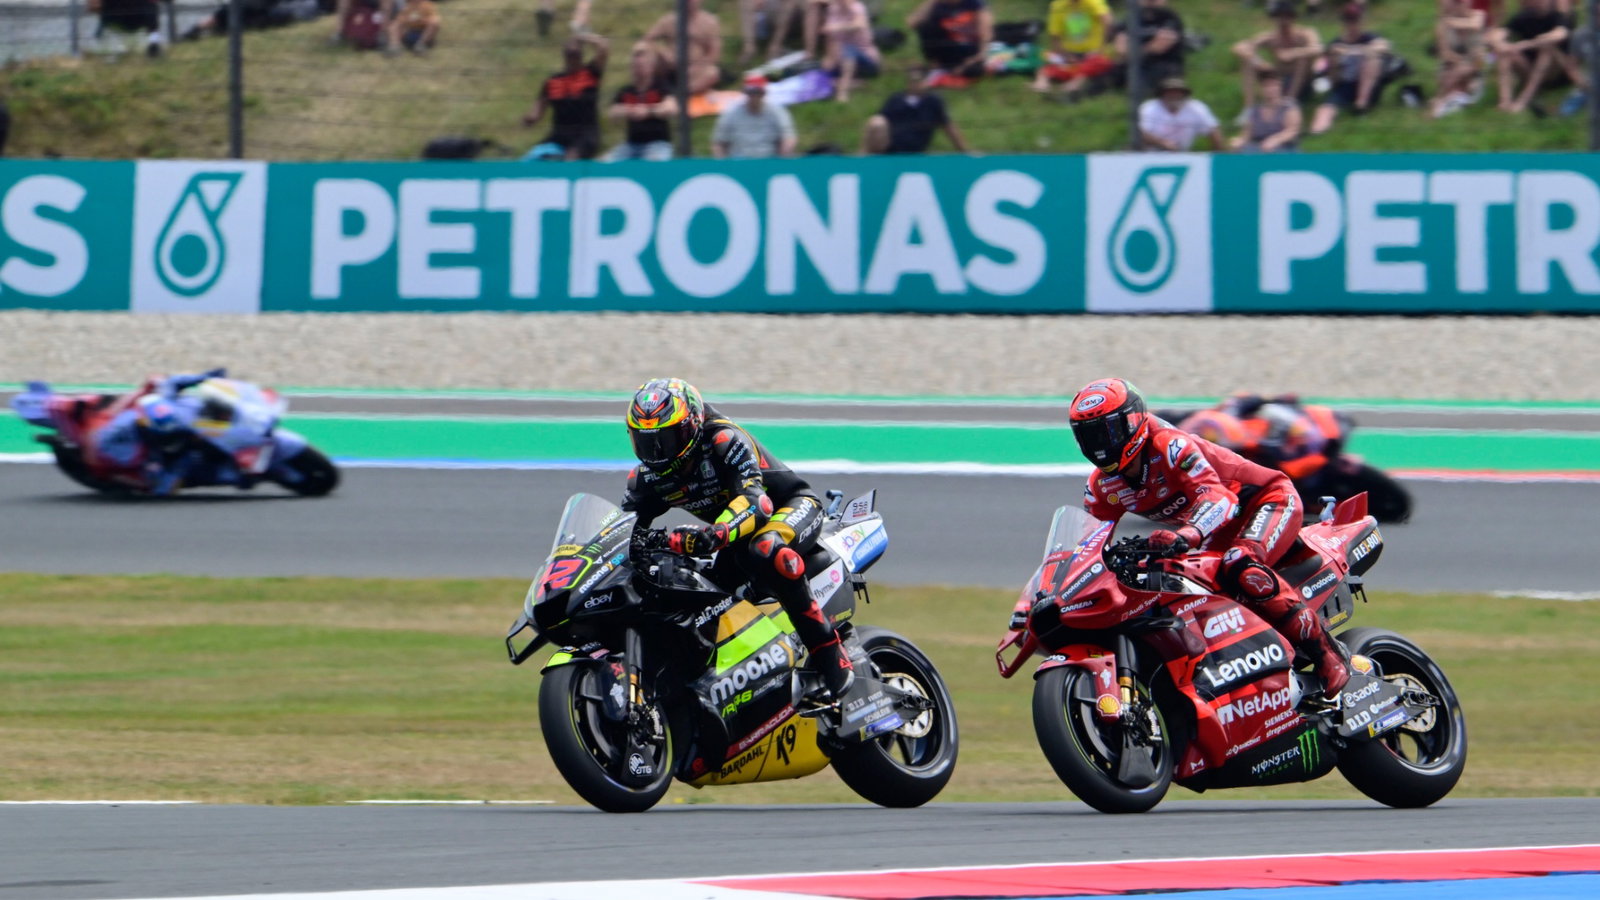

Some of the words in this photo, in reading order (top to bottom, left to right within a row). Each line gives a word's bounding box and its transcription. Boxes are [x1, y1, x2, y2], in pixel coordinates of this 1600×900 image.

[311, 172, 1046, 298] PETRONAS
[1259, 171, 1600, 293] PETR
[643, 472, 660, 483] FIL
[584, 591, 613, 609] ebay
[1061, 571, 1092, 600] motorola
[1203, 607, 1246, 639] GIVI
[710, 634, 795, 705] mooney
[1202, 643, 1284, 688] Lenovo
[1230, 687, 1291, 719] NetApp
[1264, 707, 1293, 729] SIEMENS
[738, 705, 795, 750] BARRACUDA
[720, 745, 765, 779] BARDAHL
[1251, 745, 1301, 774] MONSTER
